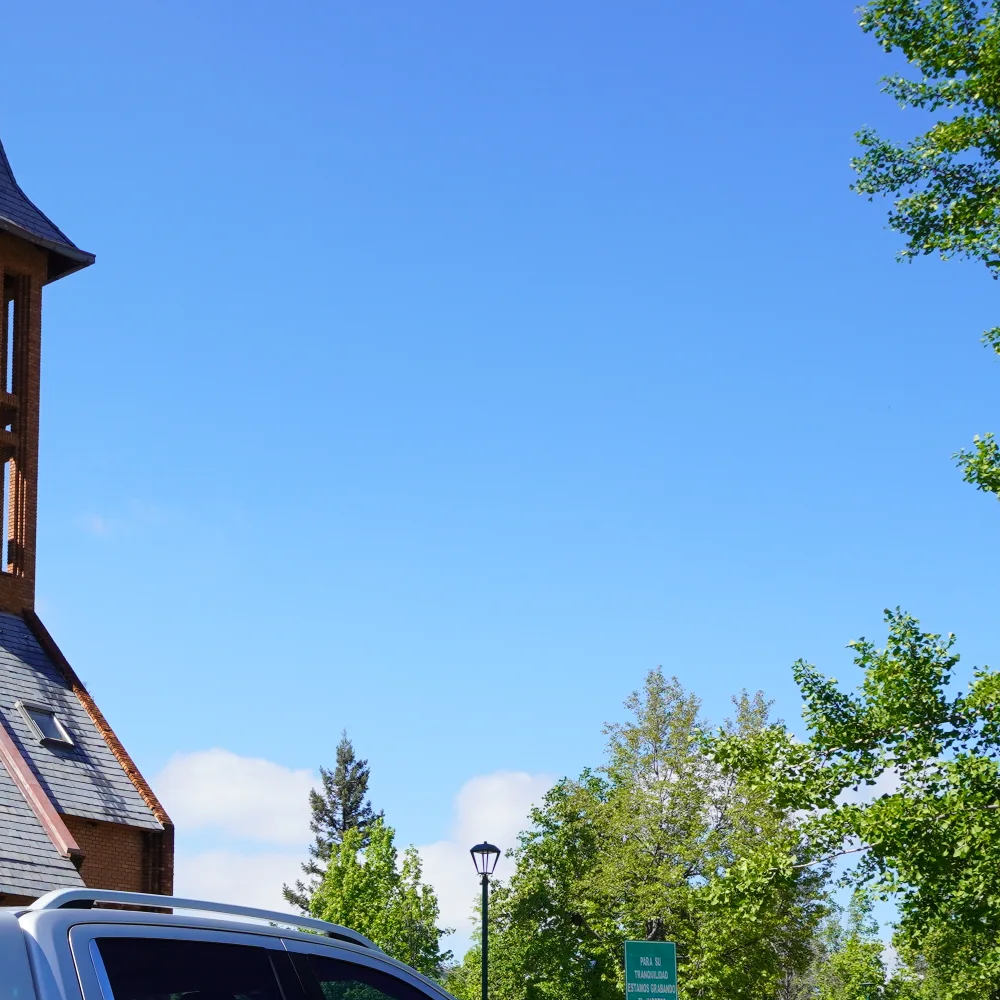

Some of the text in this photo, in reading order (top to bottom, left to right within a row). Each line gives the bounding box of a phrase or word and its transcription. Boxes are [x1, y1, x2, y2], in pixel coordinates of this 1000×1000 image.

[640, 957, 661, 966] PARA SU
[634, 970, 668, 979] TRANQUILIDAD
[628, 983, 675, 993] ESTAMOS GRABANDO
